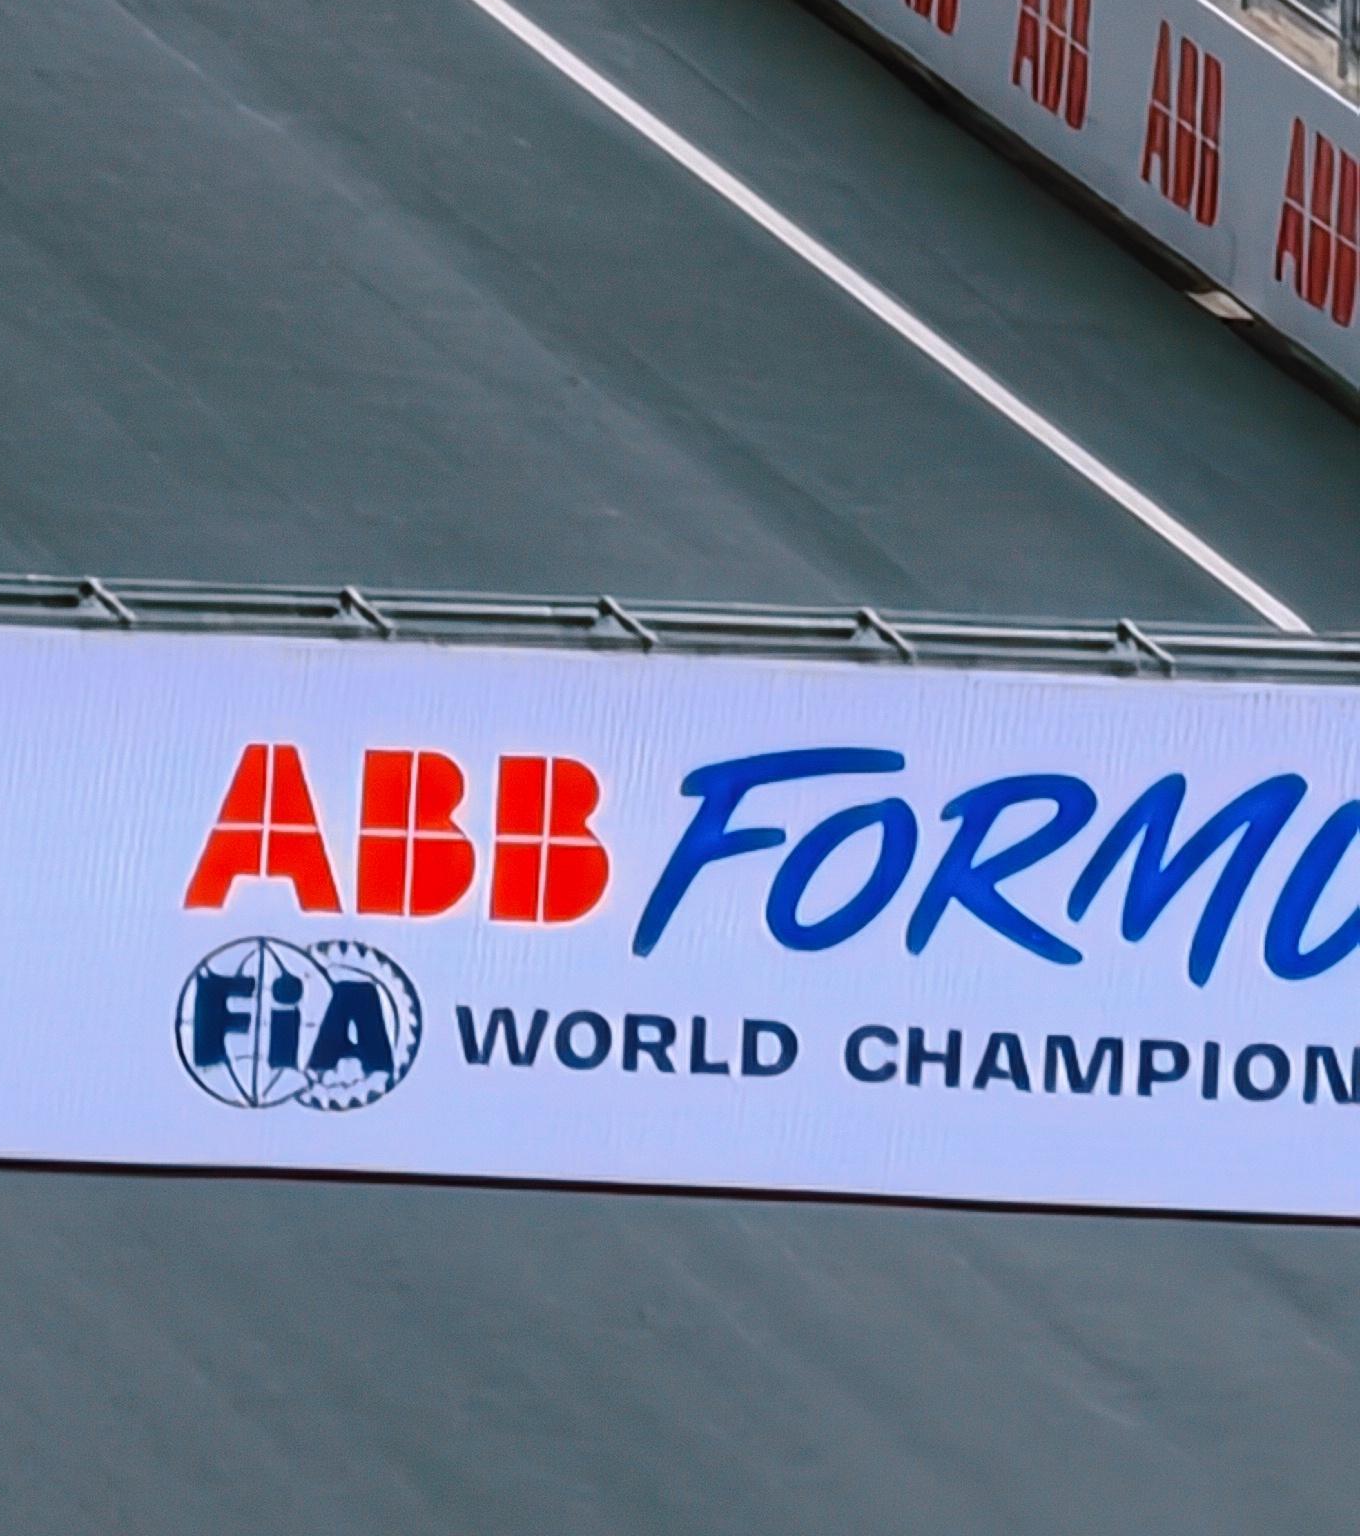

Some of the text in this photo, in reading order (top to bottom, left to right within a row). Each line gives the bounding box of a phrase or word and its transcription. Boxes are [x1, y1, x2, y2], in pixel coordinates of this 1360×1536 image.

[1140, 18, 1223, 227] ABB
[184, 743, 610, 924] ABB
[456, 1005, 799, 1077] WORLD
[844, 1024, 1360, 1105] CHAMPION
